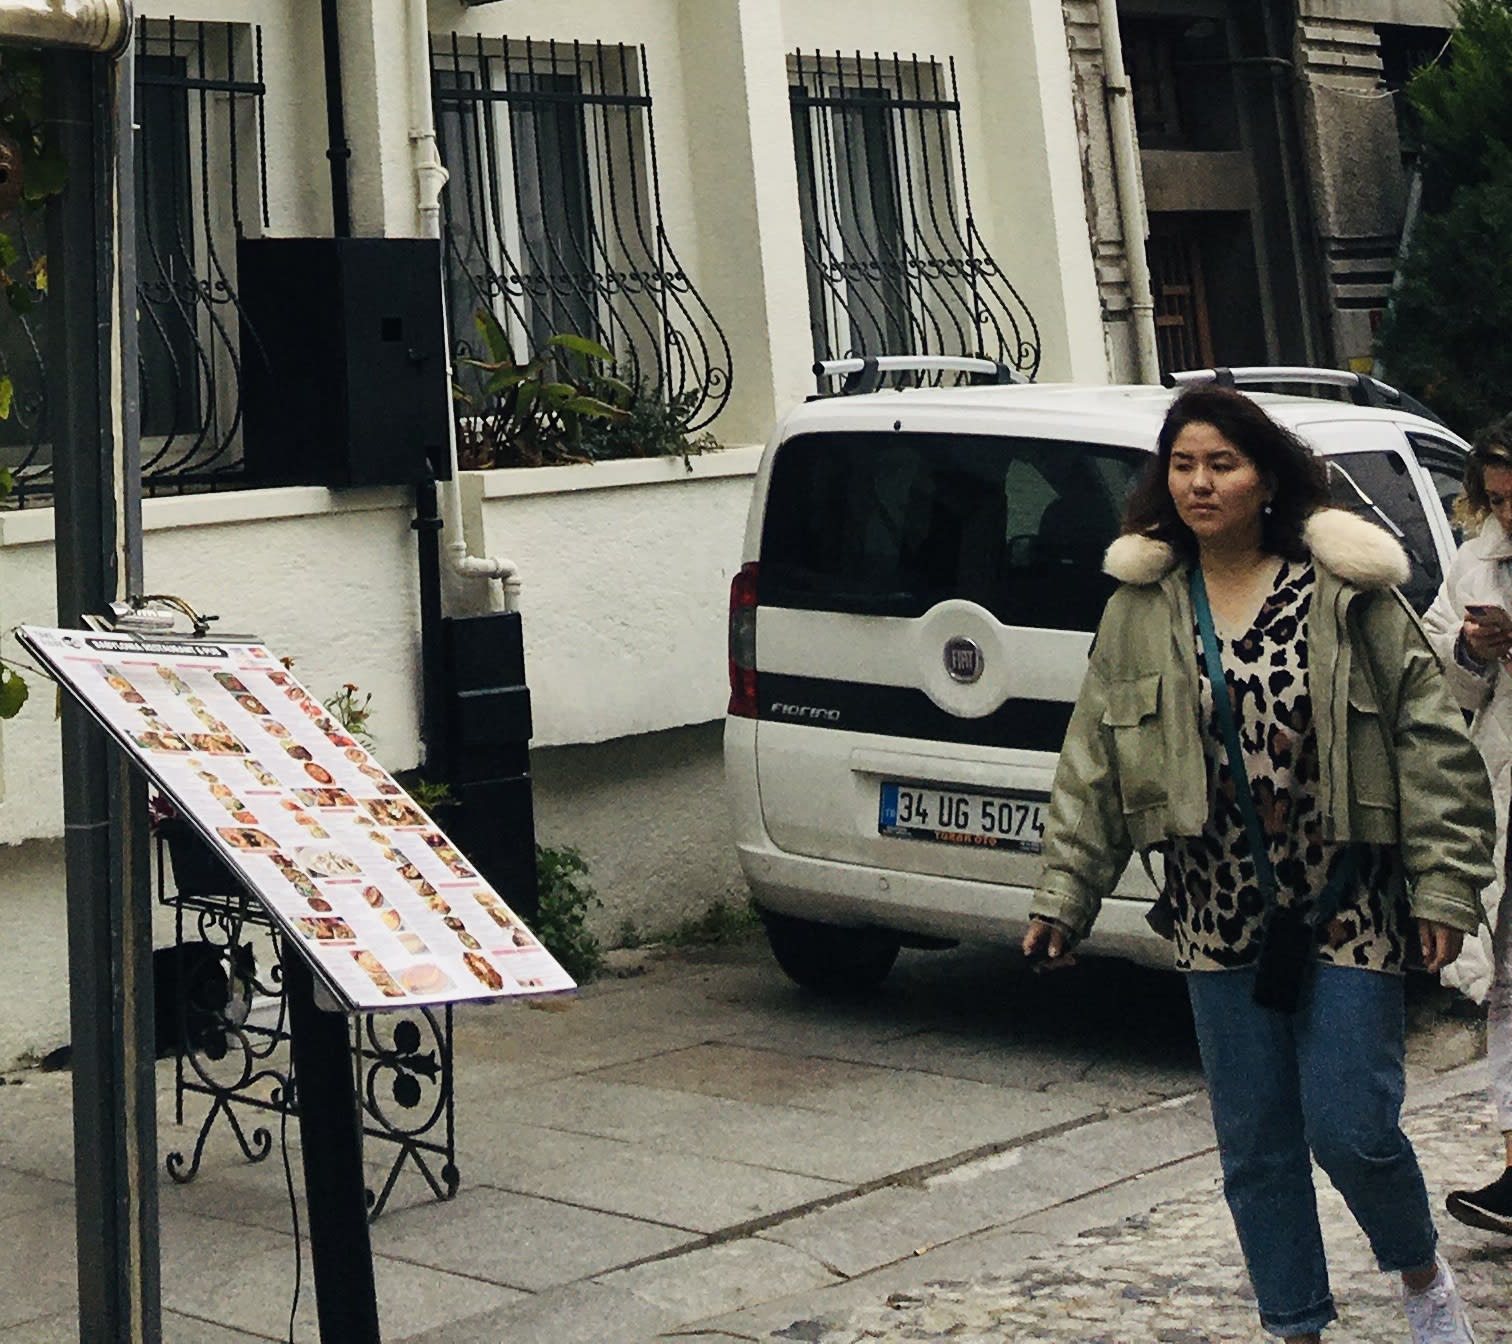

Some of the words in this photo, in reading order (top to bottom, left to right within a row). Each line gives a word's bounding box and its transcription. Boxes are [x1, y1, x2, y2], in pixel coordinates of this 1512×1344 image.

[952, 649, 974, 670] FIAT
[899, 792, 928, 825] 34
[938, 795, 969, 829] UG
[981, 800, 1046, 838] 5074
